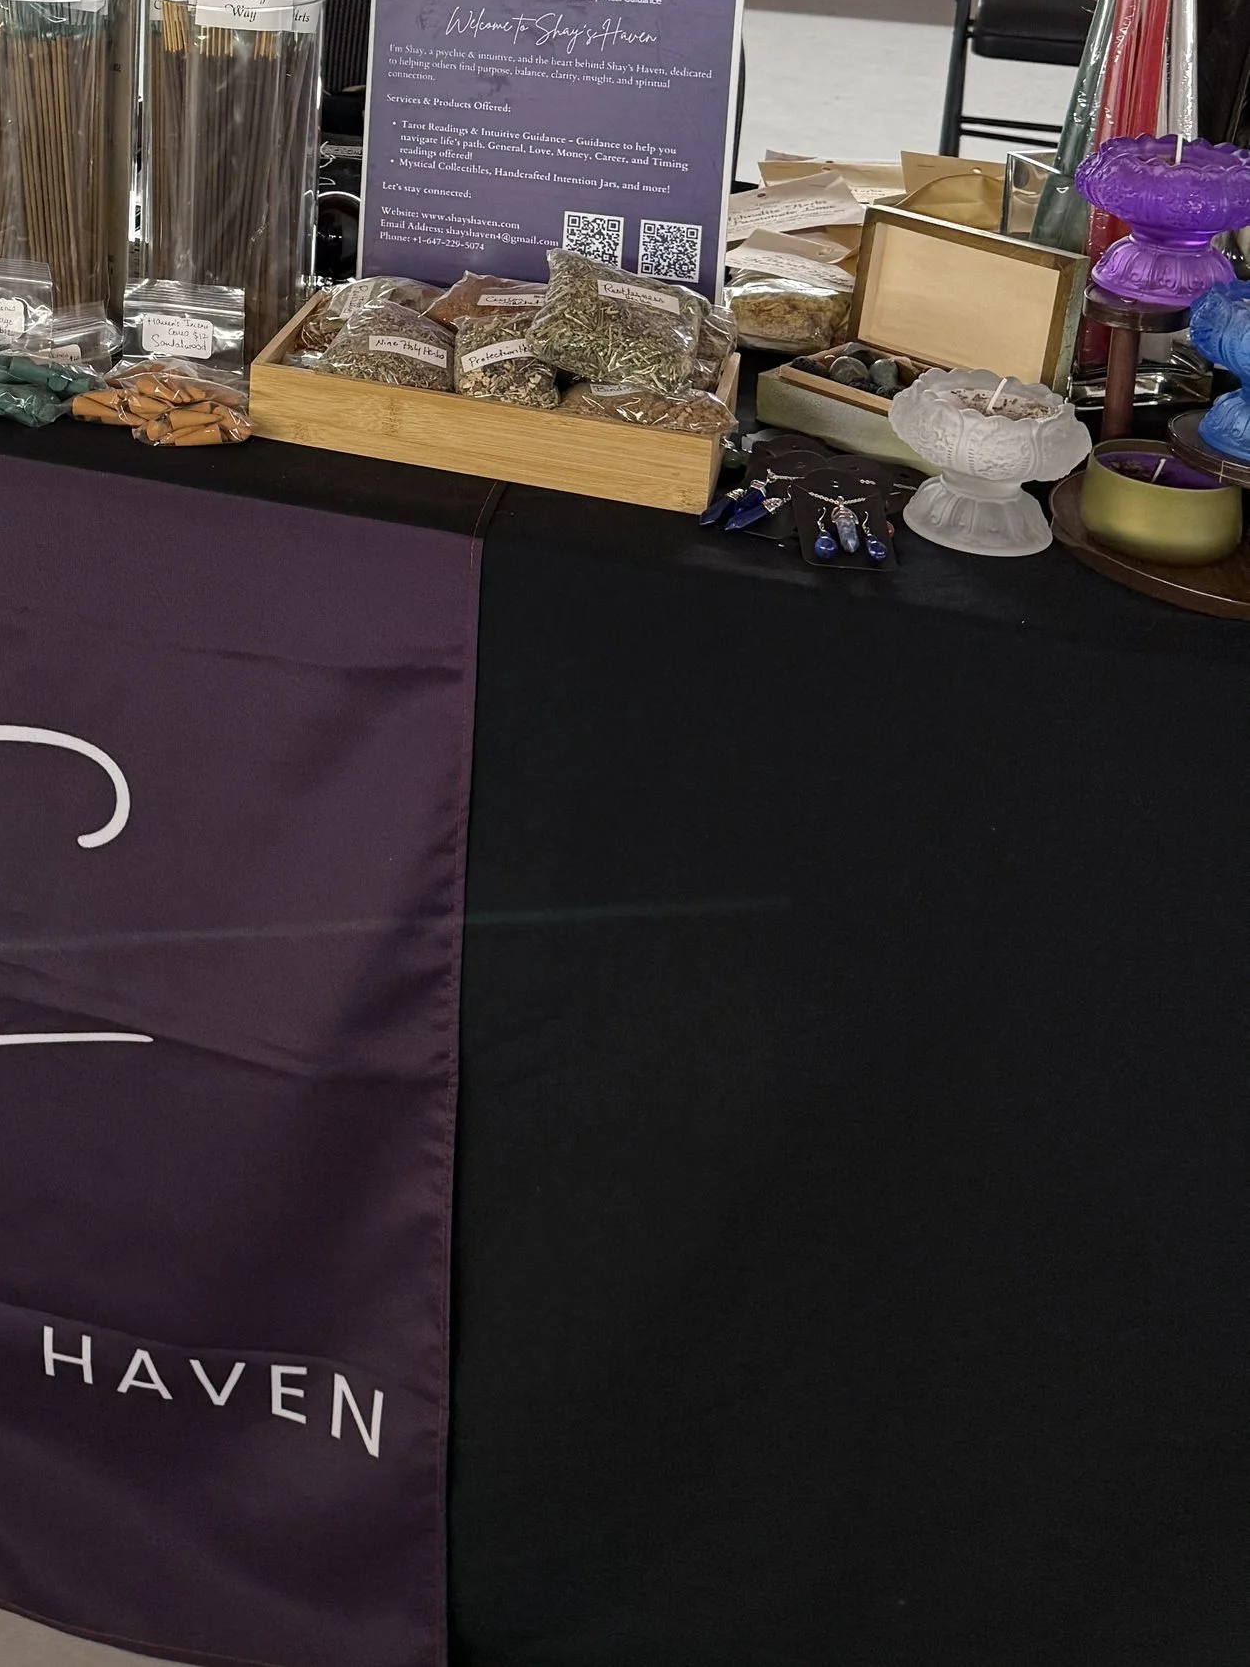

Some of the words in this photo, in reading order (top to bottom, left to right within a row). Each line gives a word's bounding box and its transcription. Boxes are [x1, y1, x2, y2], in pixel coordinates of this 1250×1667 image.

[224, 3, 258, 22] Way
[445, 6, 513, 38] Welcome
[512, 13, 536, 44] to
[535, 12, 594, 54] Shay's
[594, 17, 657, 51] Haven
[387, 71, 435, 80] connection.
[389, 43, 402, 52] I'm
[435, 48, 465, 58] psychic
[517, 54, 533, 63] and
[535, 54, 549, 64] the
[551, 56, 575, 68] heart
[575, 58, 605, 70] behind
[606, 61, 634, 74] Shay's
[669, 66, 712, 79] dedicated
[399, 56, 430, 70] helping
[431, 59, 456, 69] others
[459, 61, 475, 71] find
[616, 75, 633, 84] and
[635, 78, 670, 88] spiritual
[386, 93, 421, 104] Services
[422, 97, 430, 105] &
[433, 97, 471, 109] Products
[473, 101, 510, 112] Offered:
[399, 145, 436, 158] readings
[438, 148, 472, 160] offered!
[400, 134, 438, 145] navigate
[440, 135, 460, 146] life's
[630, 156, 649, 165] and
[651, 157, 688, 171] Timing
[401, 119, 425, 129] Tarot
[428, 122, 468, 136] Readings
[469, 126, 478, 135] &
[481, 127, 519, 139] Intuitive
[522, 131, 566, 143] Guidance
[575, 136, 620, 148] Guidance
[635, 141, 656, 154] help
[658, 147, 676, 156] you
[382, 181, 402, 190] Let's
[403, 185, 421, 195] stay
[423, 187, 471, 198] connected:
[399, 157, 435, 169] Mystical
[494, 167, 550, 180] Handcrafted
[553, 173, 597, 186] Intention
[621, 181, 640, 190] and
[642, 184, 670, 193] more!
[381, 205, 418, 217] Website:
[420, 212, 519, 229] www.shayshaven.com
[379, 231, 410, 242] Phone:
[412, 235, 484, 250] +1-647-229-5074
[380, 218, 405, 228] Email
[407, 221, 443, 233] Address:
[445, 225, 559, 249] shayshaven4@gmail.com
[42, 1325, 385, 1460] HAVEN
